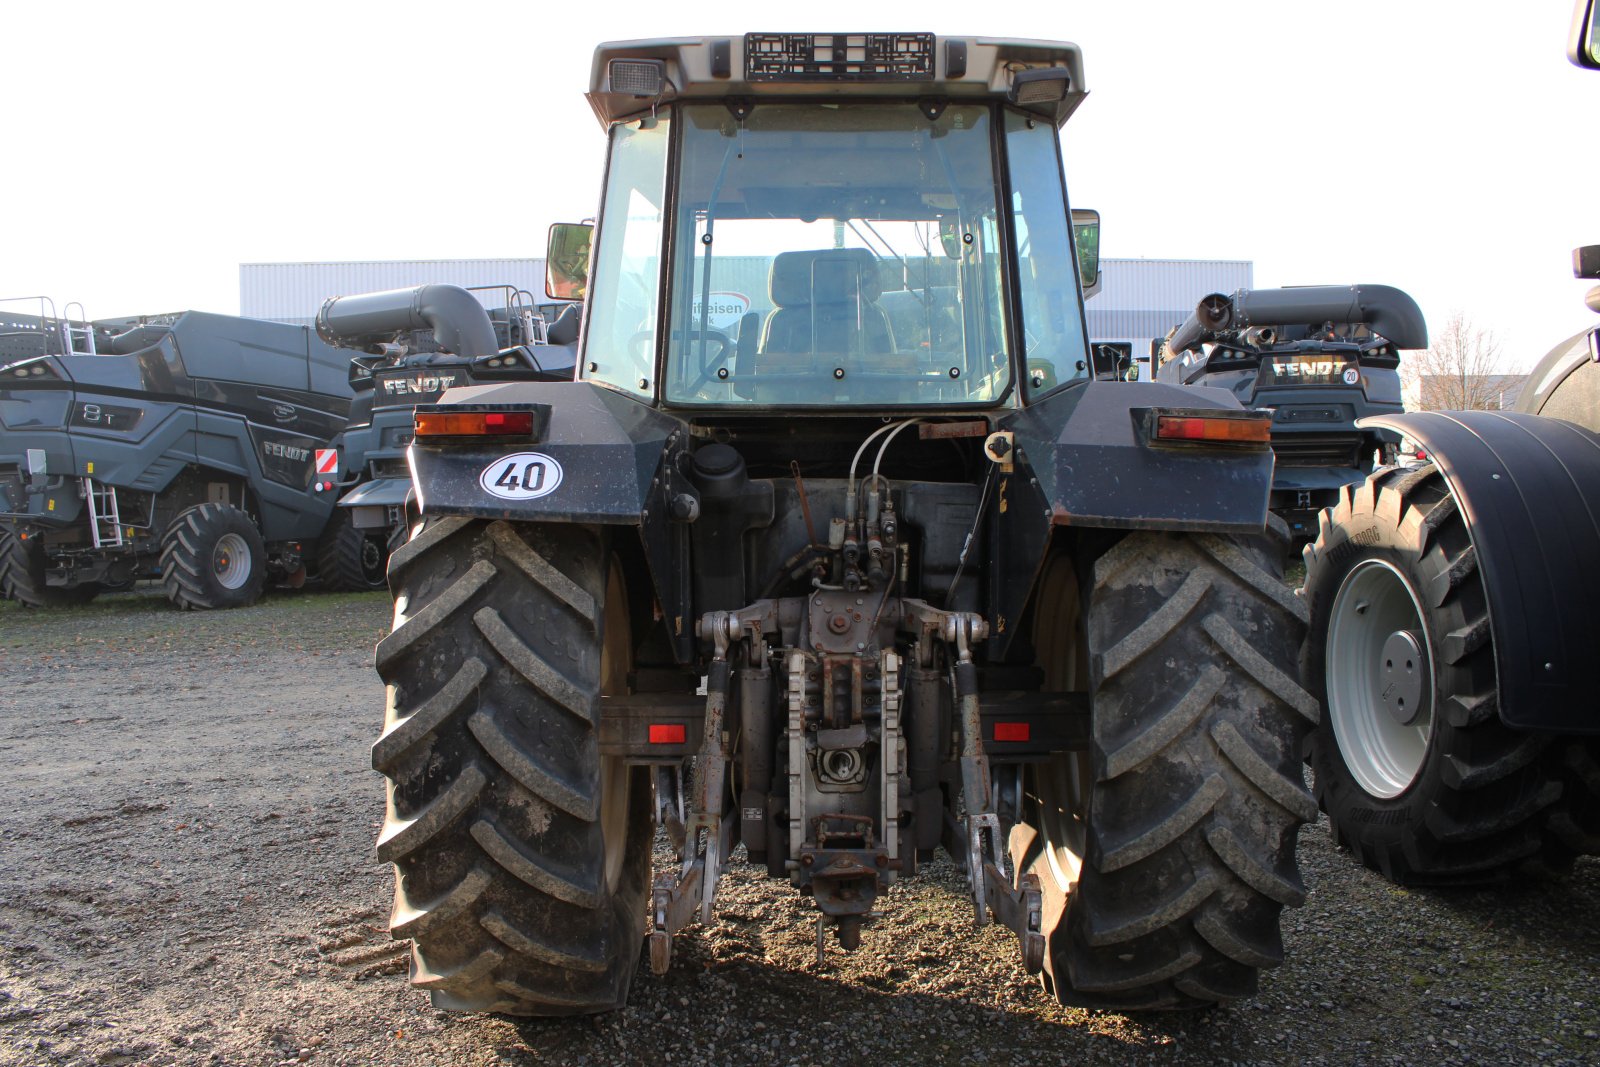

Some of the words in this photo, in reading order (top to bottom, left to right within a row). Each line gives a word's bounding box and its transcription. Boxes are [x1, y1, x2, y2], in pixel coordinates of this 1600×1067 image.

[1272, 361, 1348, 377] FENDT
[1346, 371, 1356, 382] 20
[383, 376, 456, 395] FENDT
[263, 441, 310, 462] FENDT
[495, 461, 546, 492] 40
